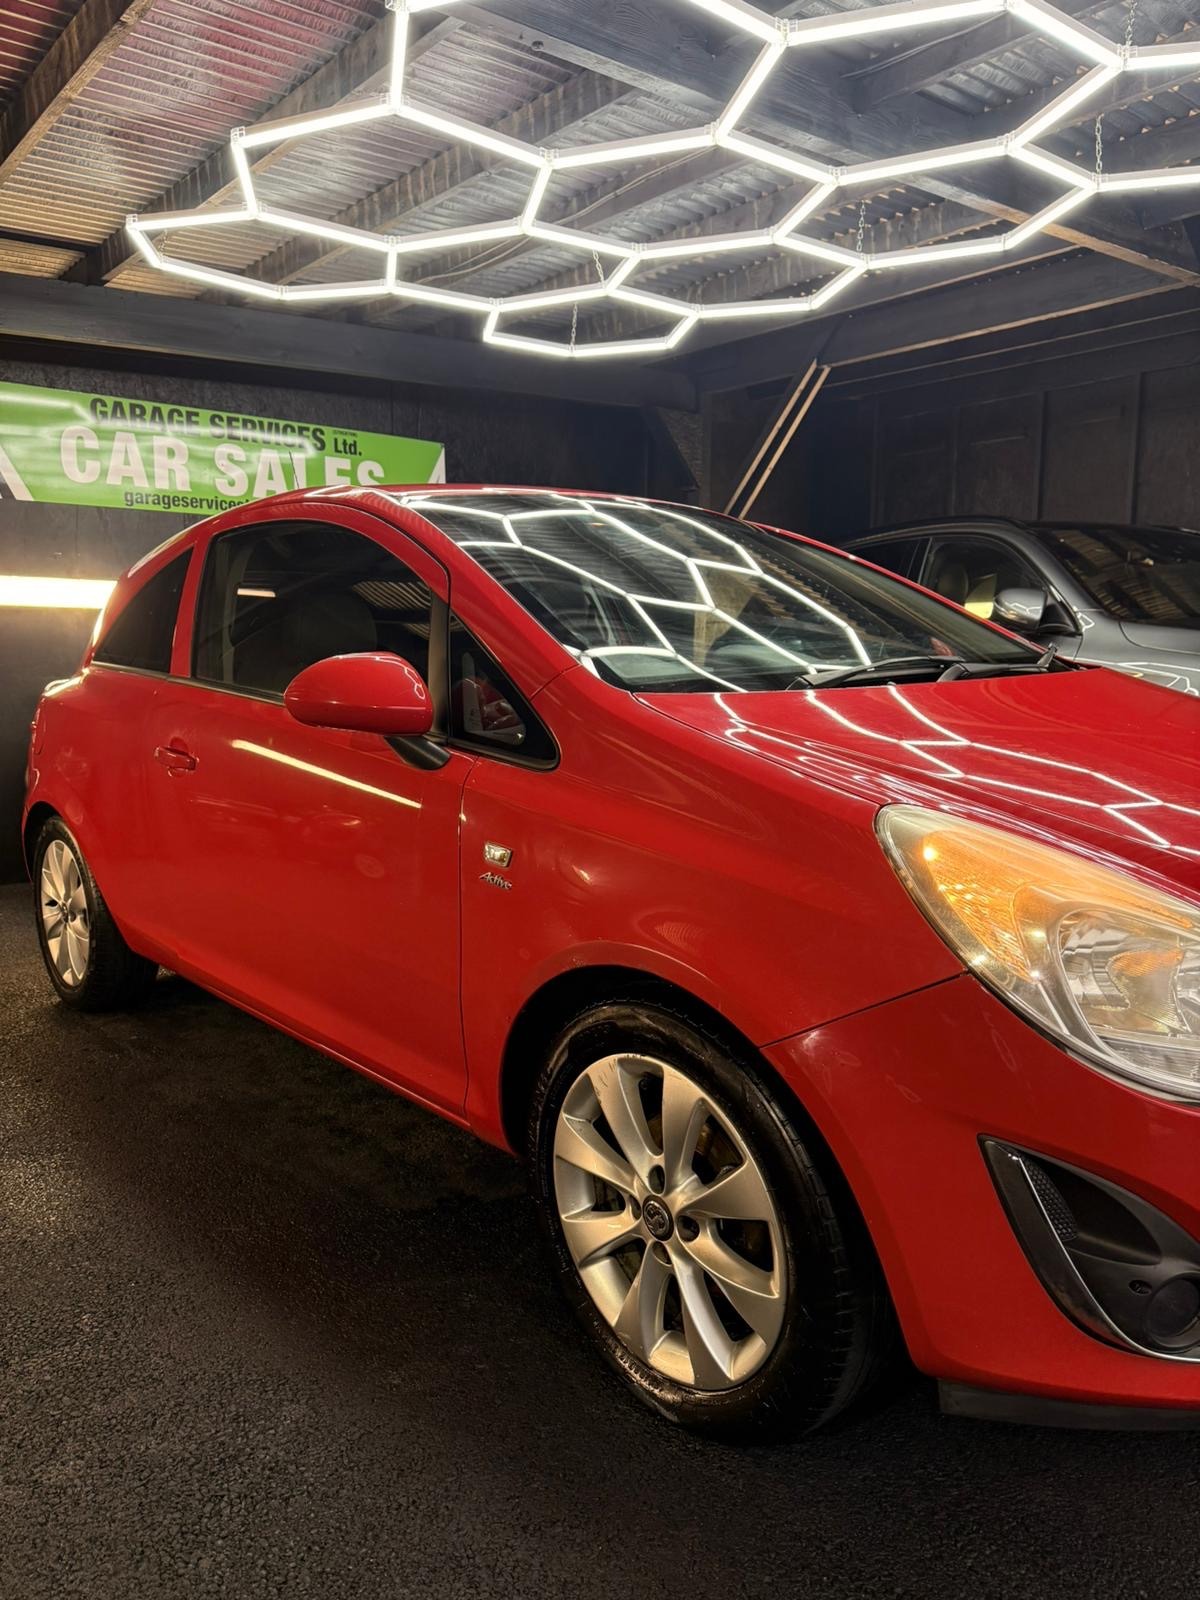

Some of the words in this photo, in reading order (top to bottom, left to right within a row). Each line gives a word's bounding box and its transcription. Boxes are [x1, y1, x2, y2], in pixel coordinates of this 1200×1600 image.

[60, 425, 191, 491] CAR
[90, 398, 200, 436] GARAGE
[209, 413, 326, 451] SERVICES
[334, 438, 362, 456] Ltd.
